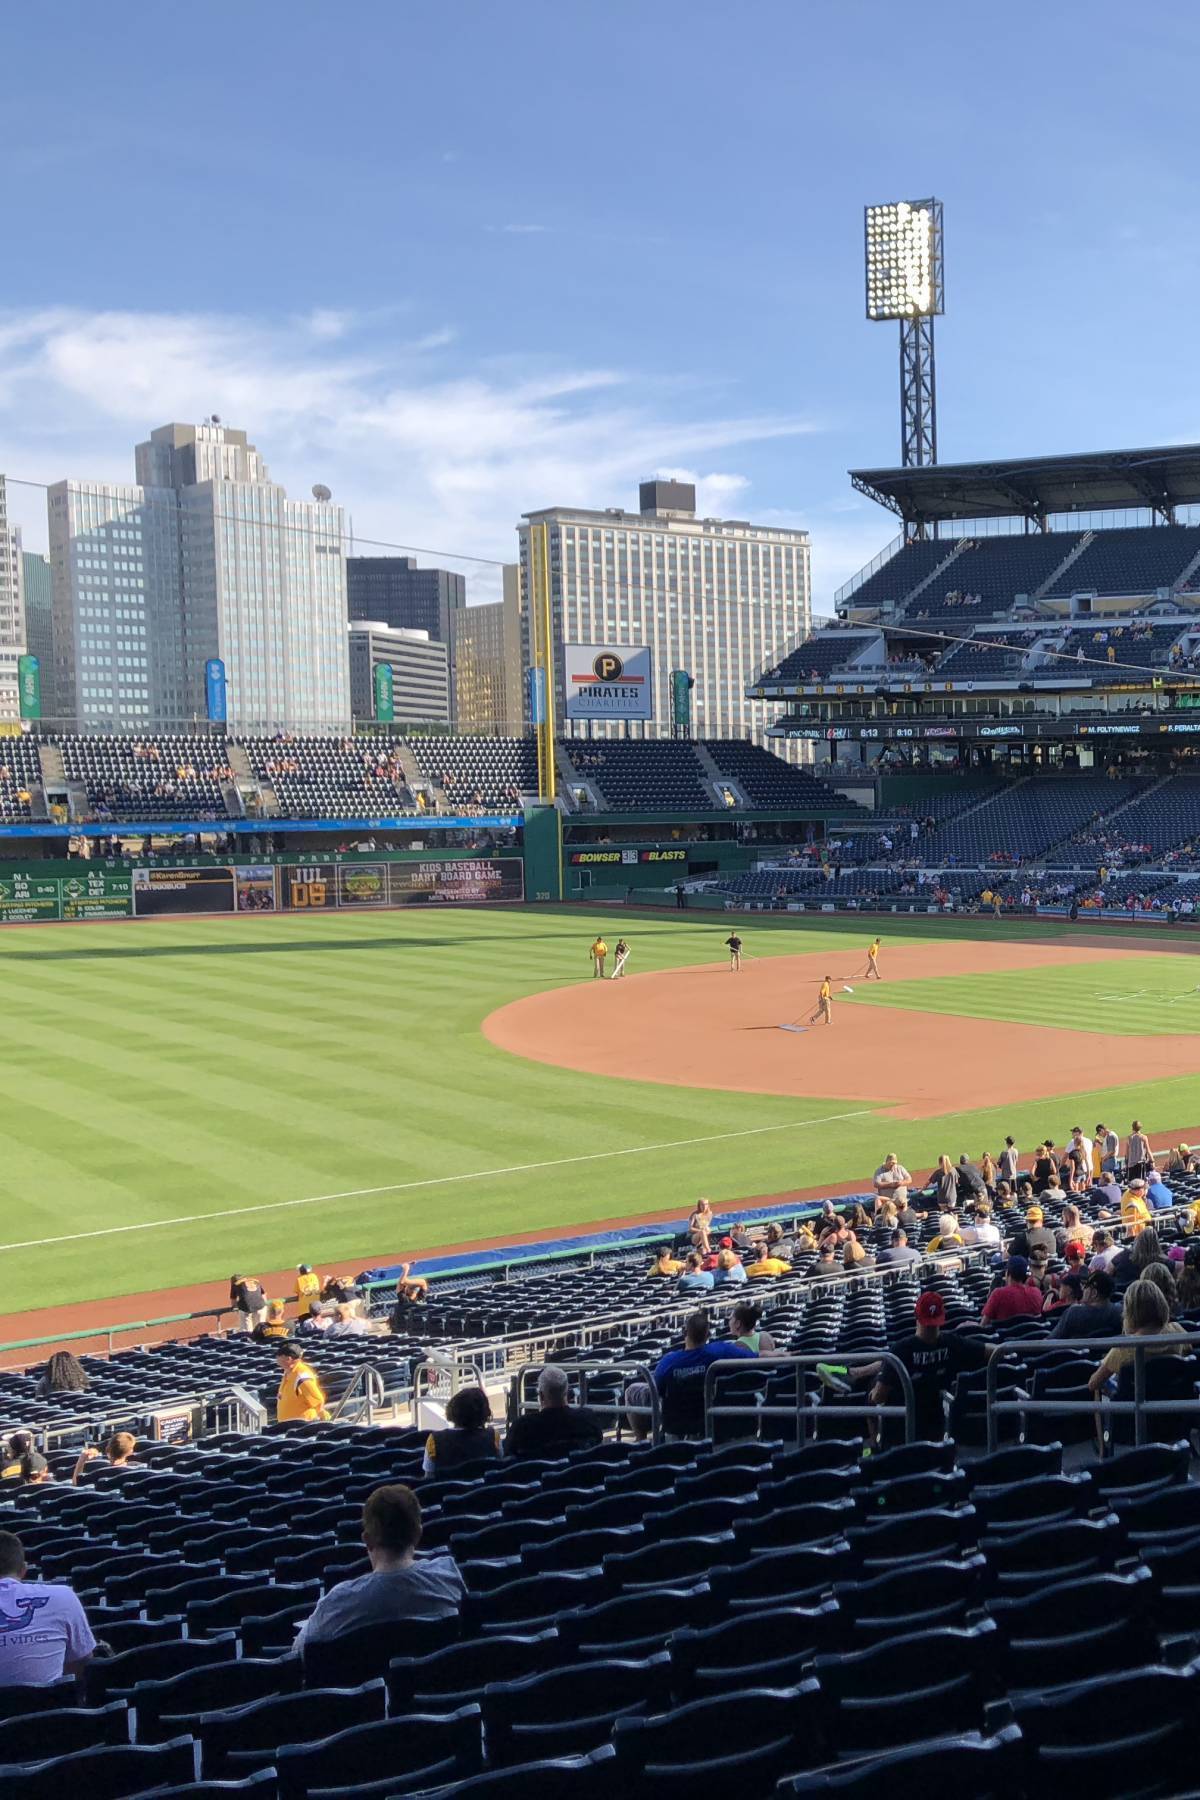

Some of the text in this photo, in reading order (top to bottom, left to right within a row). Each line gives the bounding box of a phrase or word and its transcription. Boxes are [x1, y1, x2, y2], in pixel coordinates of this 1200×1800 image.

[601, 658, 616, 678] P
[578, 686, 639, 698] PIRATES
[579, 699, 640, 708] CHARITIES
[579, 852, 621, 863] BOWSER
[649, 850, 686, 861] BLASTS
[419, 861, 494, 873] KIDS BASEBALL
[291, 867, 327, 884] JUL
[411, 870, 502, 882] DART BOARD GAME
